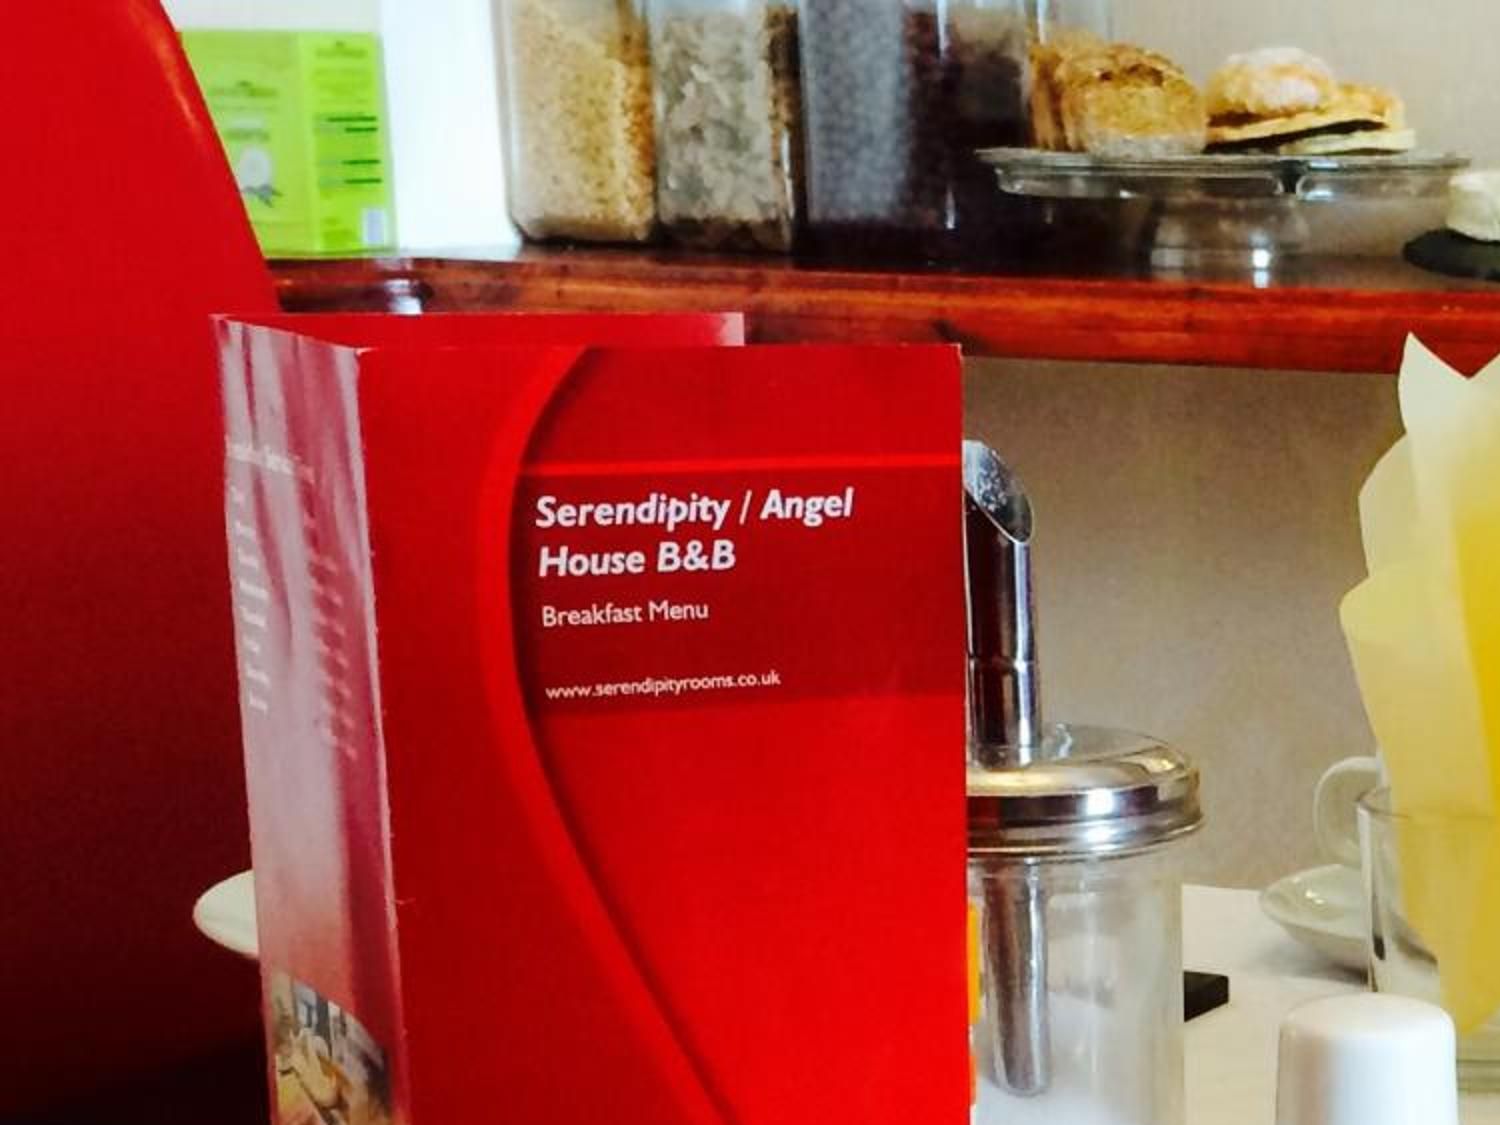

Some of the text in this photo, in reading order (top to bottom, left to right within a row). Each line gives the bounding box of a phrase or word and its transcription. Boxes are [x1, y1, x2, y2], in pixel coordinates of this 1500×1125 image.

[535, 487, 855, 531] Serendipity / Angel
[539, 539, 736, 577] House B&B
[541, 600, 709, 628] Breakfast Menu
[546, 670, 781, 700] www.serendipityrooms.co.uk
